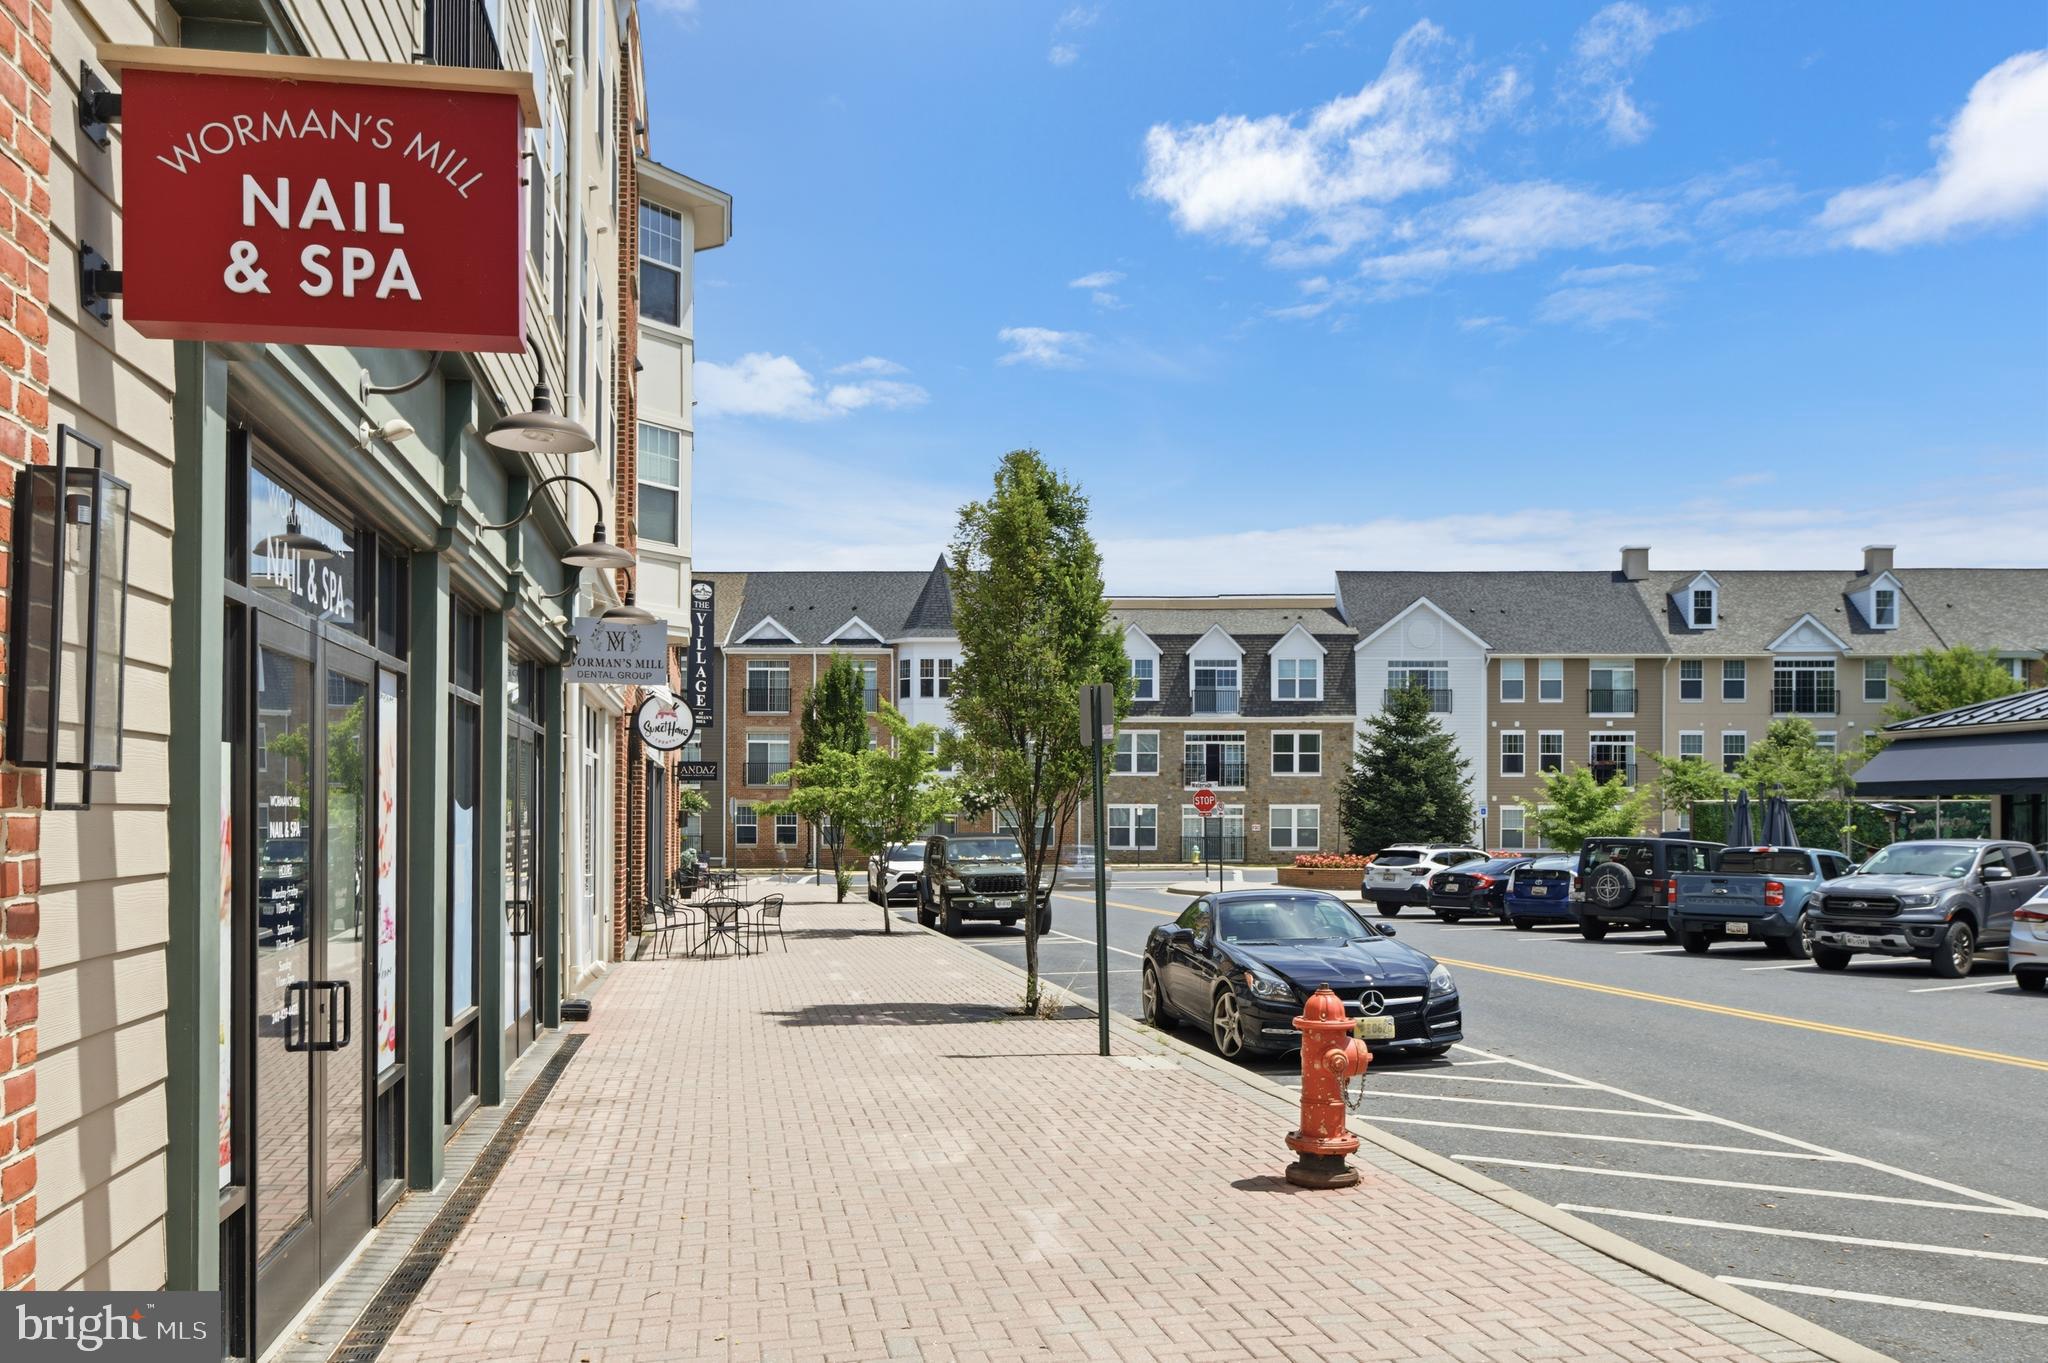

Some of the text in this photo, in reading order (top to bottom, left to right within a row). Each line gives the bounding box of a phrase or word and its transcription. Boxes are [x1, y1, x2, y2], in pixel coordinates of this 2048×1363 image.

[156, 109, 484, 200] WORMAN'S MILL
[242, 174, 405, 235] NAIL
[223, 240, 423, 301] & SPA
[266, 531, 346, 618] NAIL & SPA
[694, 601, 710, 609] THE
[635, 659, 665, 669] MILL
[695, 612, 708, 707] VILLAGE
[577, 670, 653, 680] DENTAL GROUP
[680, 765, 716, 775] ANDAZ
[1195, 796, 1215, 805] STOP
[269, 821, 301, 838] NAIL & SPA
